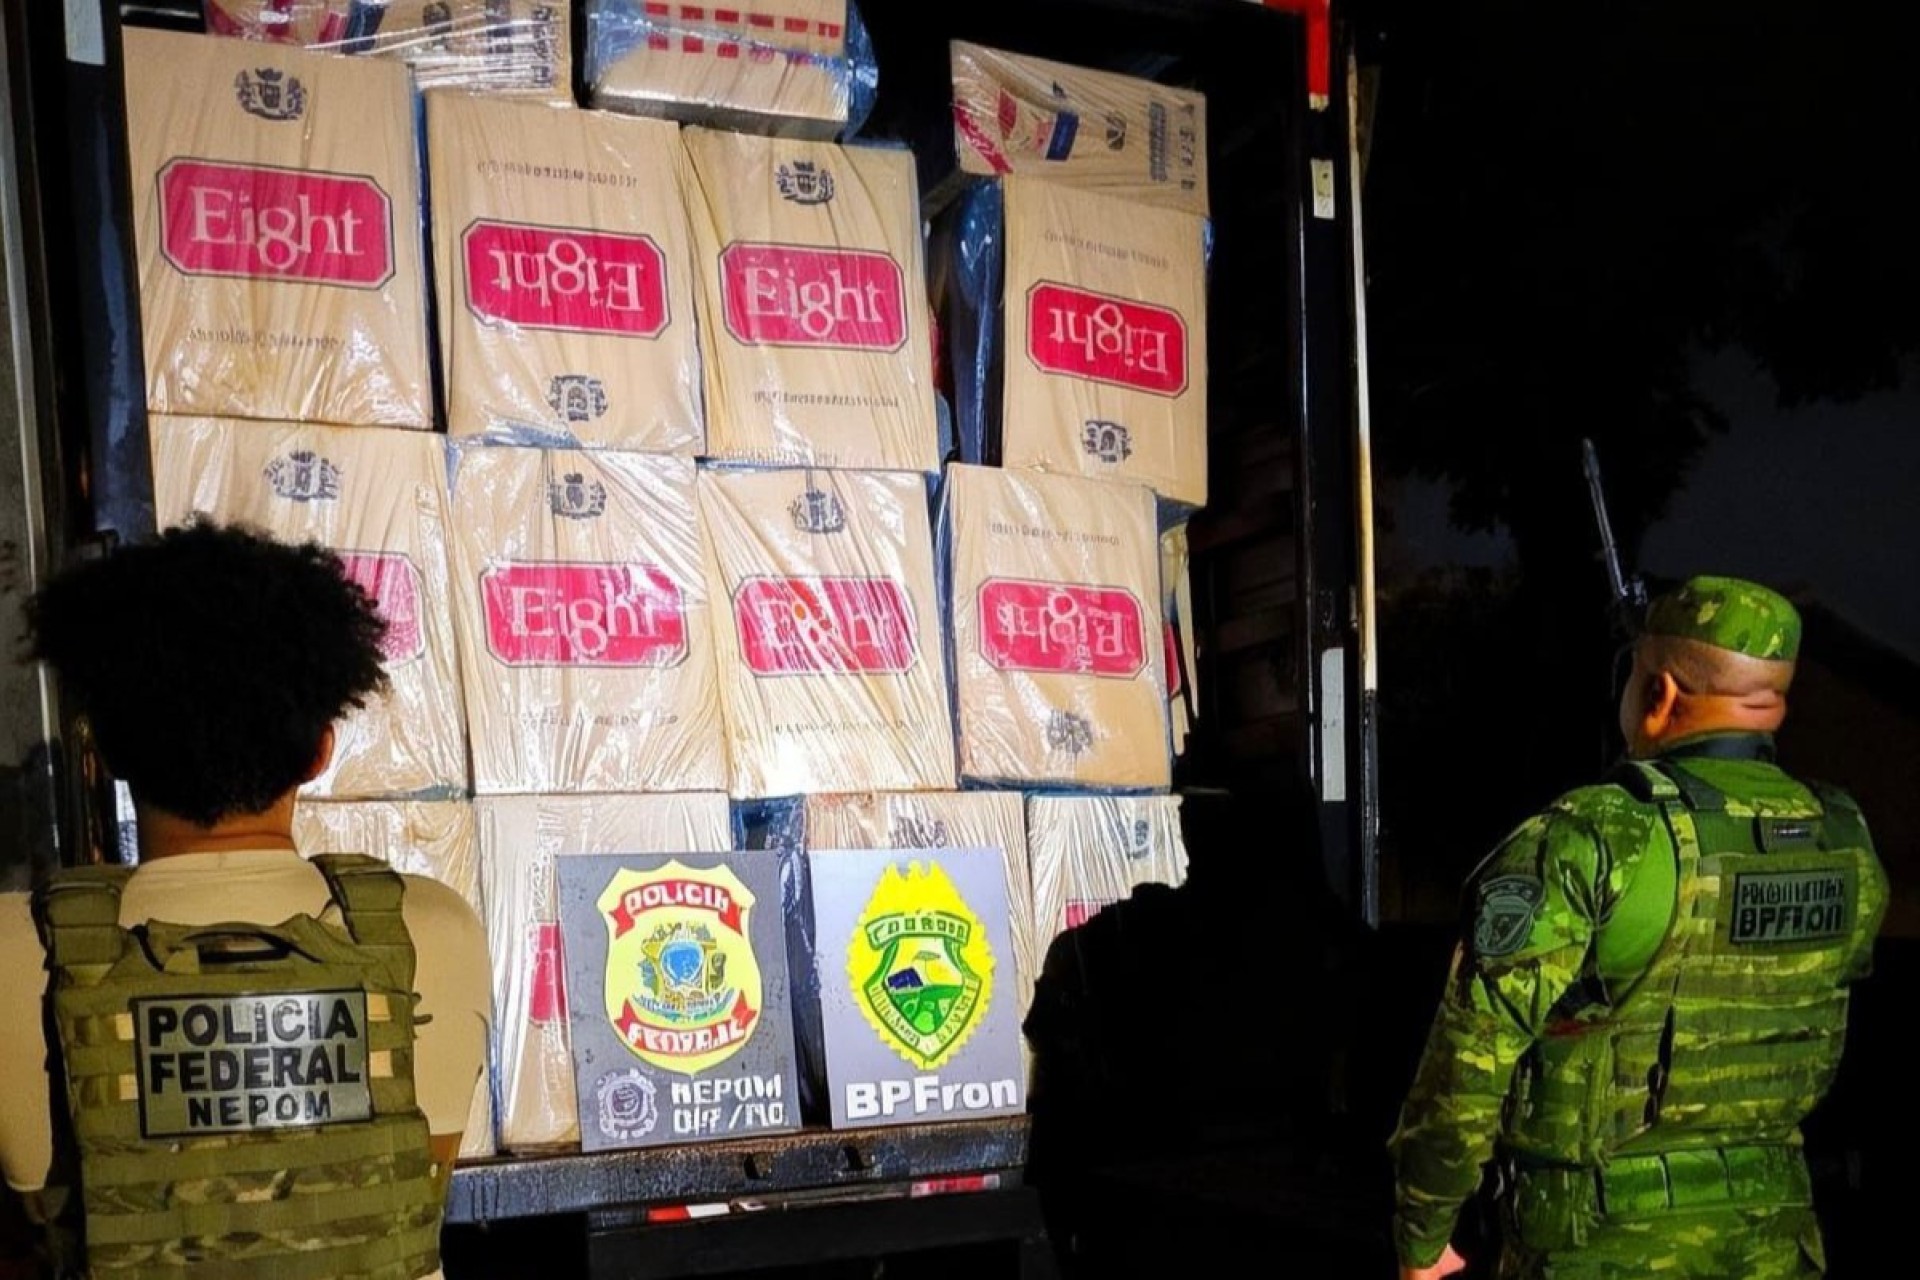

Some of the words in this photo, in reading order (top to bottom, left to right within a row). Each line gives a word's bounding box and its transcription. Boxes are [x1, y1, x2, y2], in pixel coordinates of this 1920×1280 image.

[189, 184, 366, 272] Eight
[488, 237, 646, 314] Eight
[743, 260, 885, 338] Eight
[1048, 302, 1171, 376] Eight
[511, 577, 662, 658] Eight
[150, 1044, 361, 1095] FEDERAL
[845, 1075, 1018, 1120] BPFron
[188, 1090, 332, 1127] NEPOM
